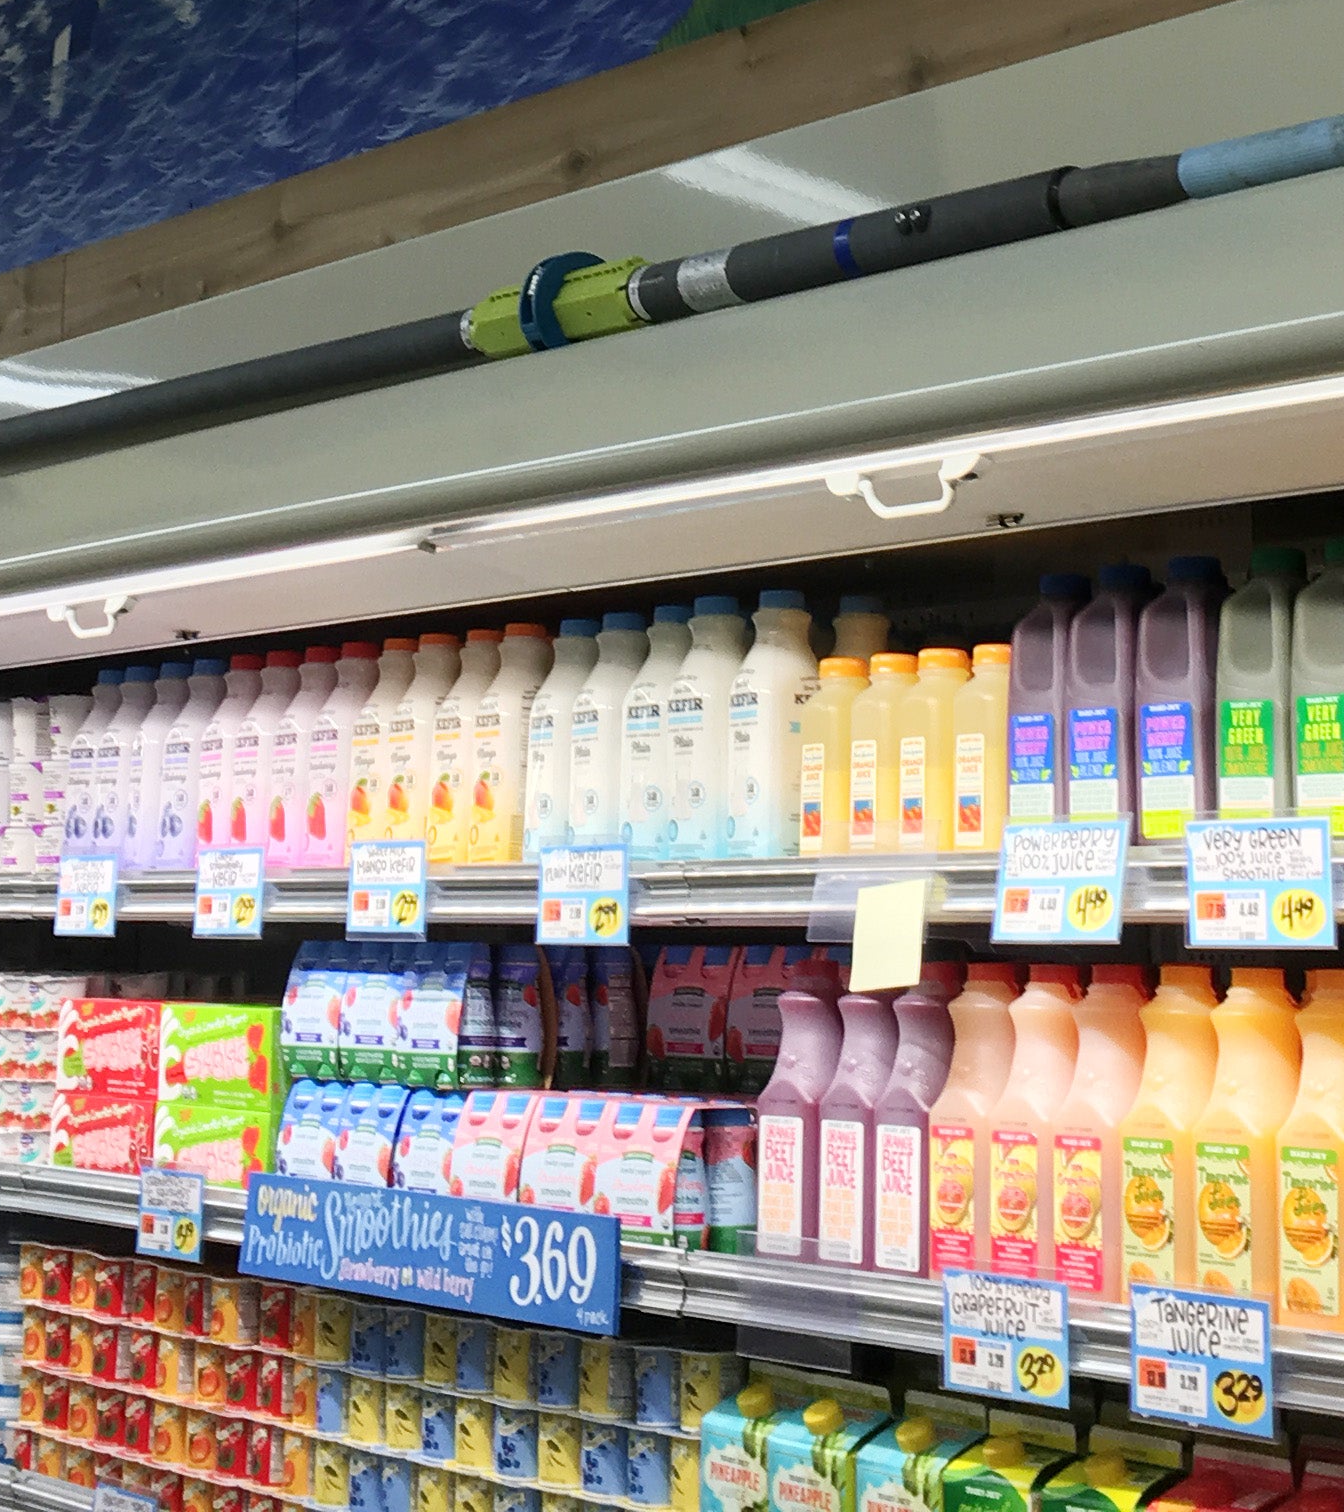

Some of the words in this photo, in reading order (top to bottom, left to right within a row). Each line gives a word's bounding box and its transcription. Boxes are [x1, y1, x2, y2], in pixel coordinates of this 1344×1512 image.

[1231, 709, 1261, 726] VERY
[1306, 704, 1337, 721] VERY
[1228, 728, 1264, 744] GREEN
[1304, 722, 1341, 741] GREEN
[1203, 829, 1243, 852] VERY
[1249, 826, 1303, 850] GREEN
[1052, 849, 1095, 876] JUICE
[1223, 866, 1286, 882] SMOOTHIE
[764, 1138, 796, 1168] BEET
[826, 1143, 857, 1173] BEET
[882, 1149, 913, 1180] BEET
[257, 1184, 319, 1233] organic
[246, 1224, 324, 1269] Probiotic
[320, 1190, 457, 1280] Smoothies
[501, 1215, 598, 1307] $3.69
[951, 1291, 1040, 1323] GRAPEFRUIT
[1151, 1297, 1249, 1335] TANGERINE
[981, 1316, 1026, 1342] JUICE
[1167, 1326, 1221, 1359] JUICE
[709, 1460, 761, 1491] PINEAPPLE
[778, 1480, 832, 1507] PINEAPPLE
